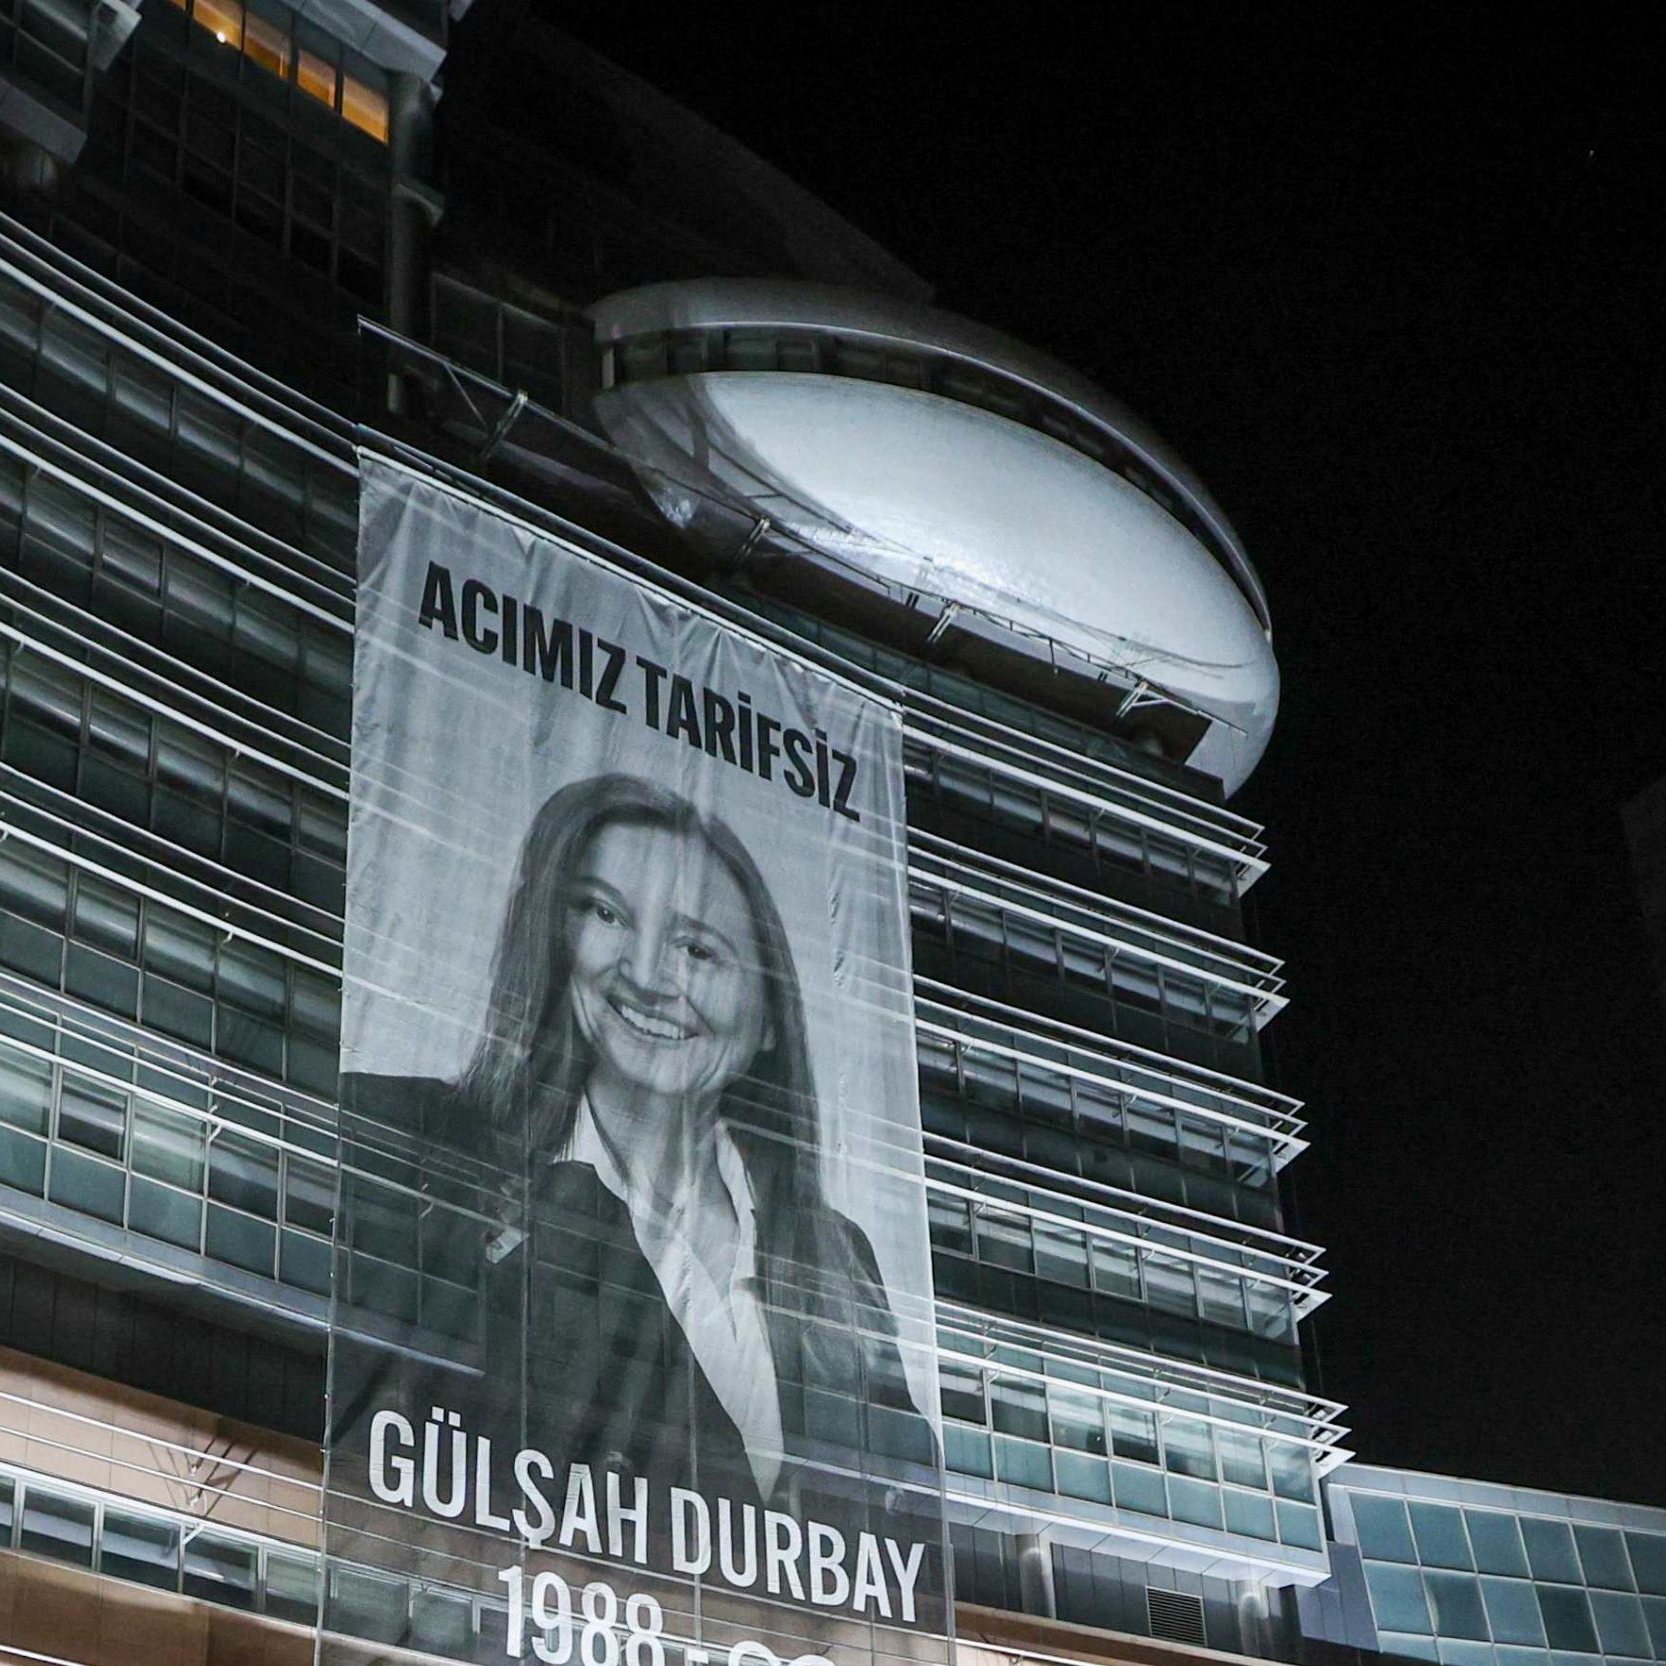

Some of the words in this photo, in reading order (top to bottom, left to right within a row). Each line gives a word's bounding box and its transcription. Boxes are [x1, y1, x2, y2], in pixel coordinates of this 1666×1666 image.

[419, 560, 627, 714] ACIMIZ
[636, 656, 860, 822] TARİFSİZ
[369, 1406, 649, 1565] GÜLŞAH
[670, 1486, 925, 1623] DURBAY
